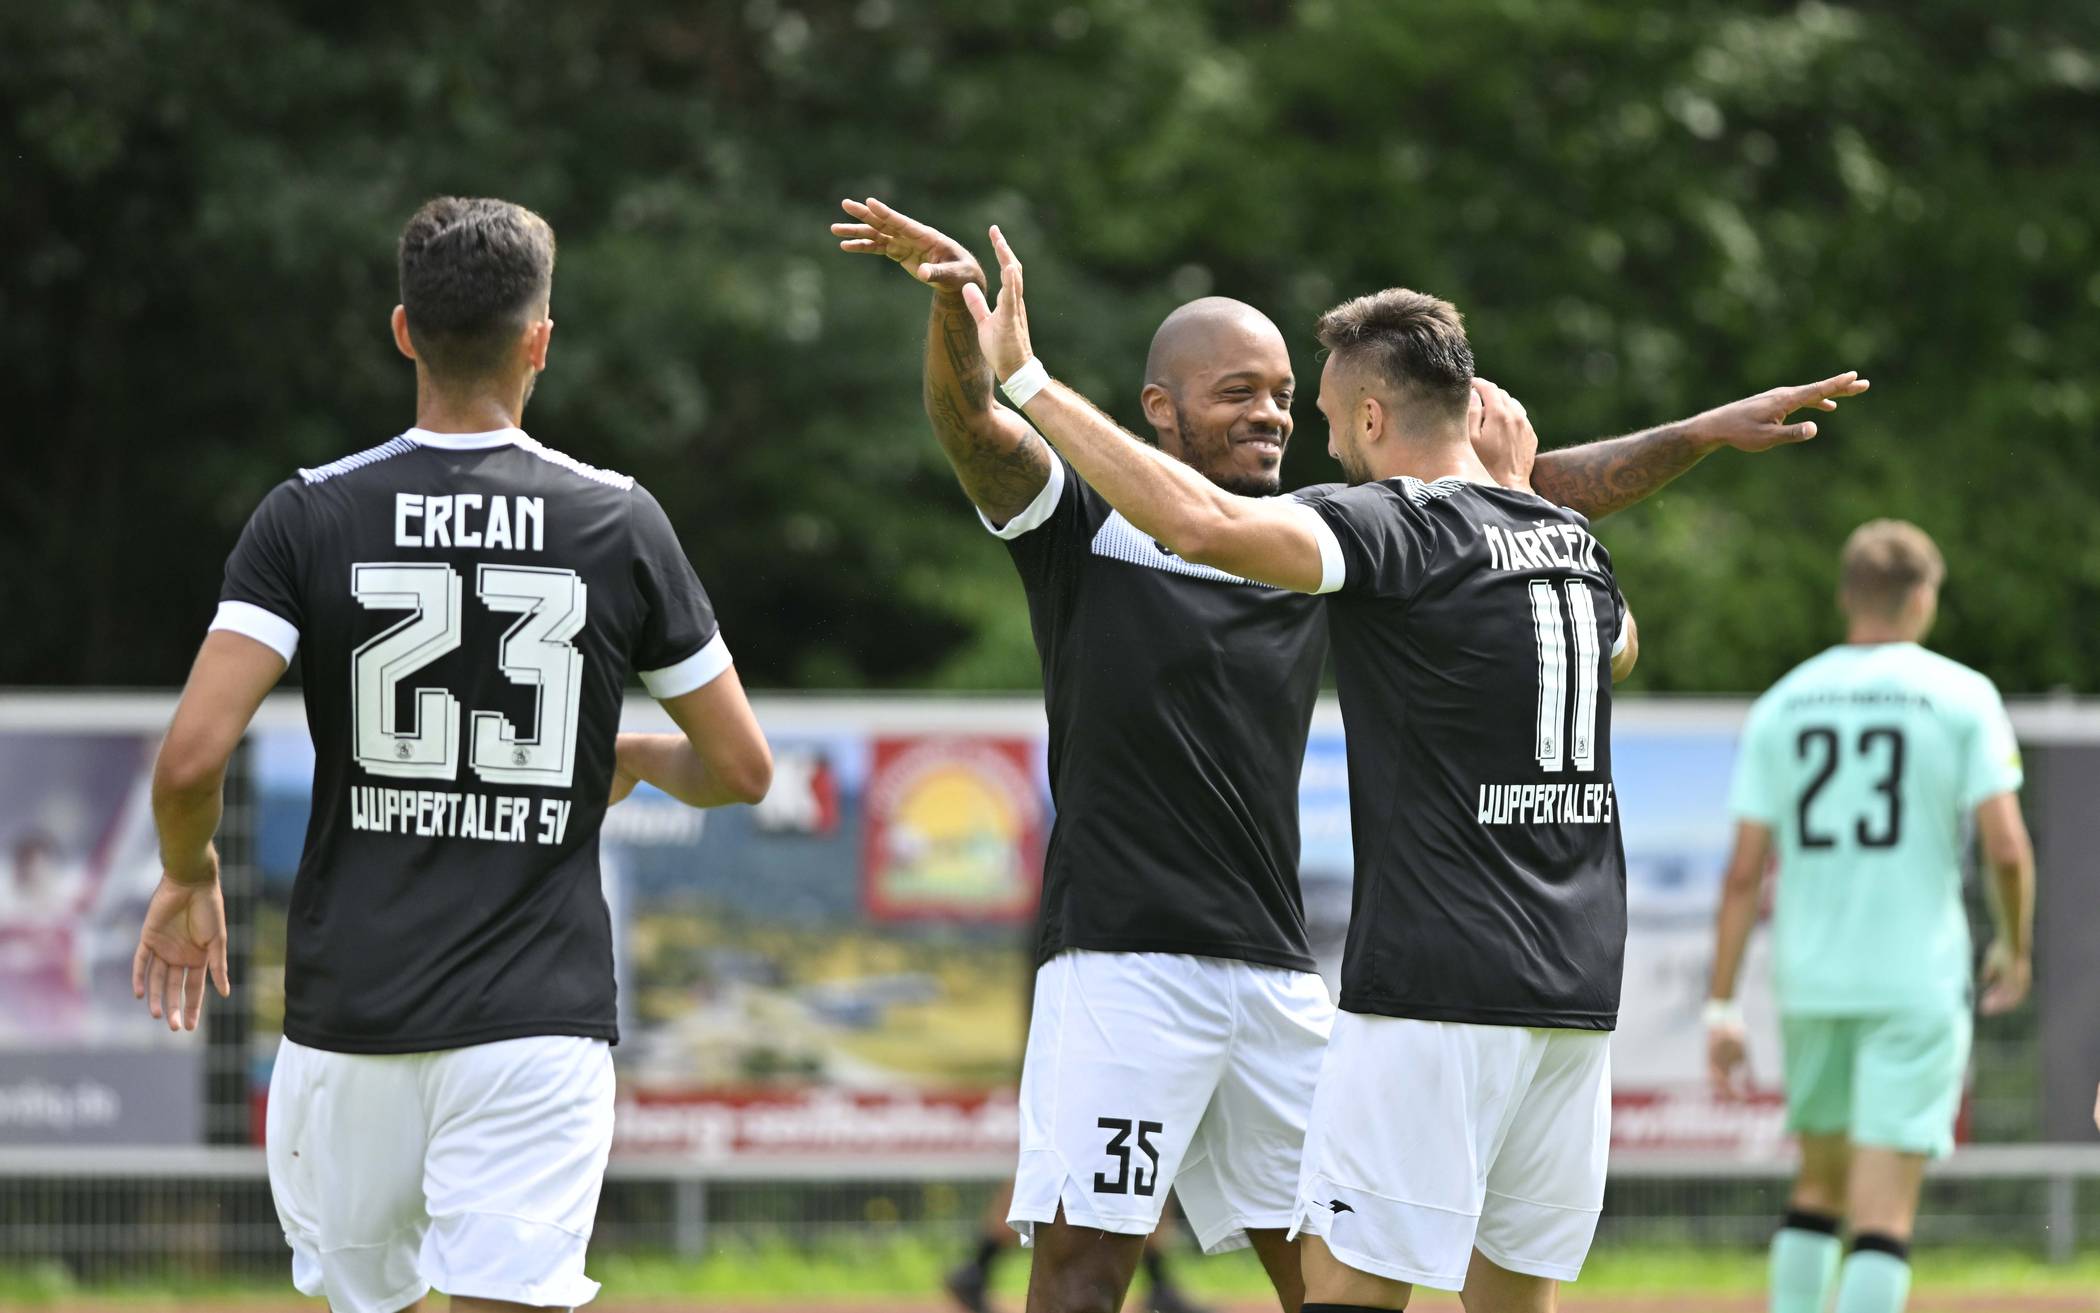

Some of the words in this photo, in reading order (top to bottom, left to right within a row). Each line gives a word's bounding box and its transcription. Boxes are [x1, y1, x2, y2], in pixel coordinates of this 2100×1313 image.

[395, 493, 544, 551] ERCAN
[351, 562, 587, 788] 23
[1528, 578, 1600, 772] 11
[351, 786, 530, 843] WUPPERTALER
[537, 798, 572, 845] SV
[1478, 784, 1603, 824] WUPPERTALER
[1798, 729, 1904, 849] 23
[1094, 1117, 1163, 1197] 35
